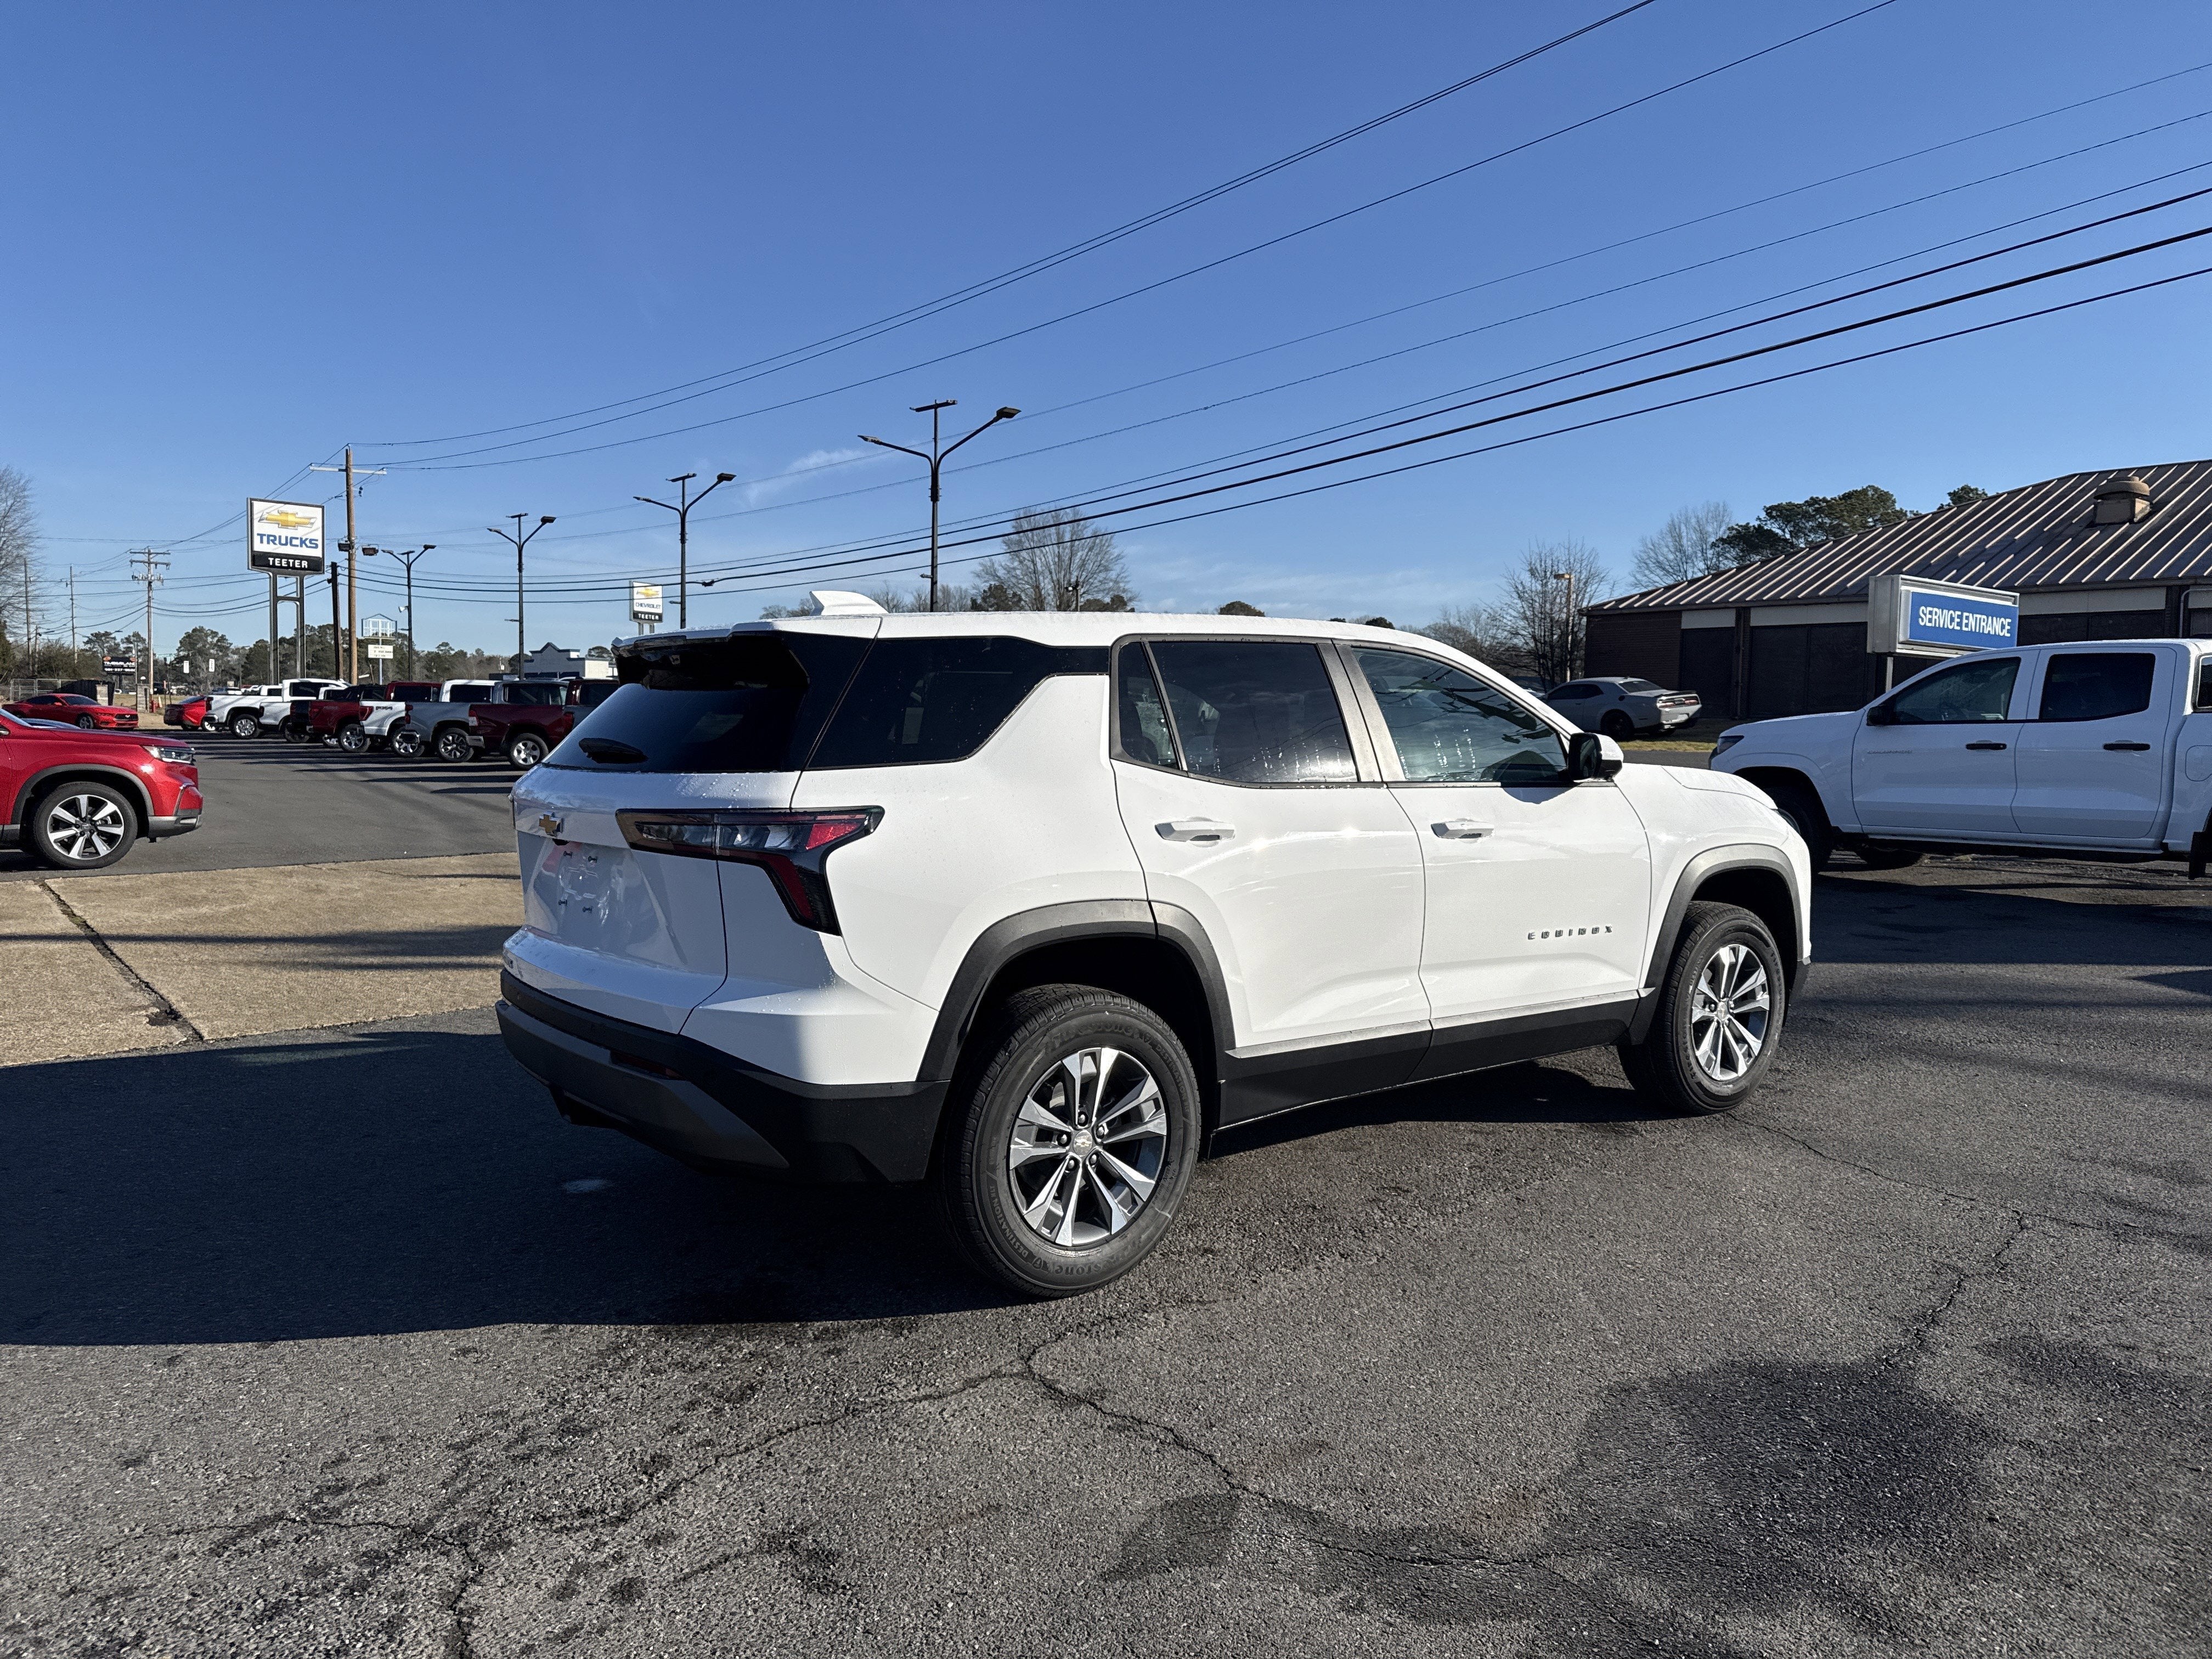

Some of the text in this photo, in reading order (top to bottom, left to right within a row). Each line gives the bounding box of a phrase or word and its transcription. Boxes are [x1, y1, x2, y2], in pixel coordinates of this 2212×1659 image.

[256, 533, 319, 549] TRUCKS
[268, 557, 308, 568] TEETER
[1918, 606, 2012, 637] SERVICE ENTRANCE
[1527, 925, 1612, 940] EQUINOX
[991, 1198, 1029, 1259] DESTINATION
